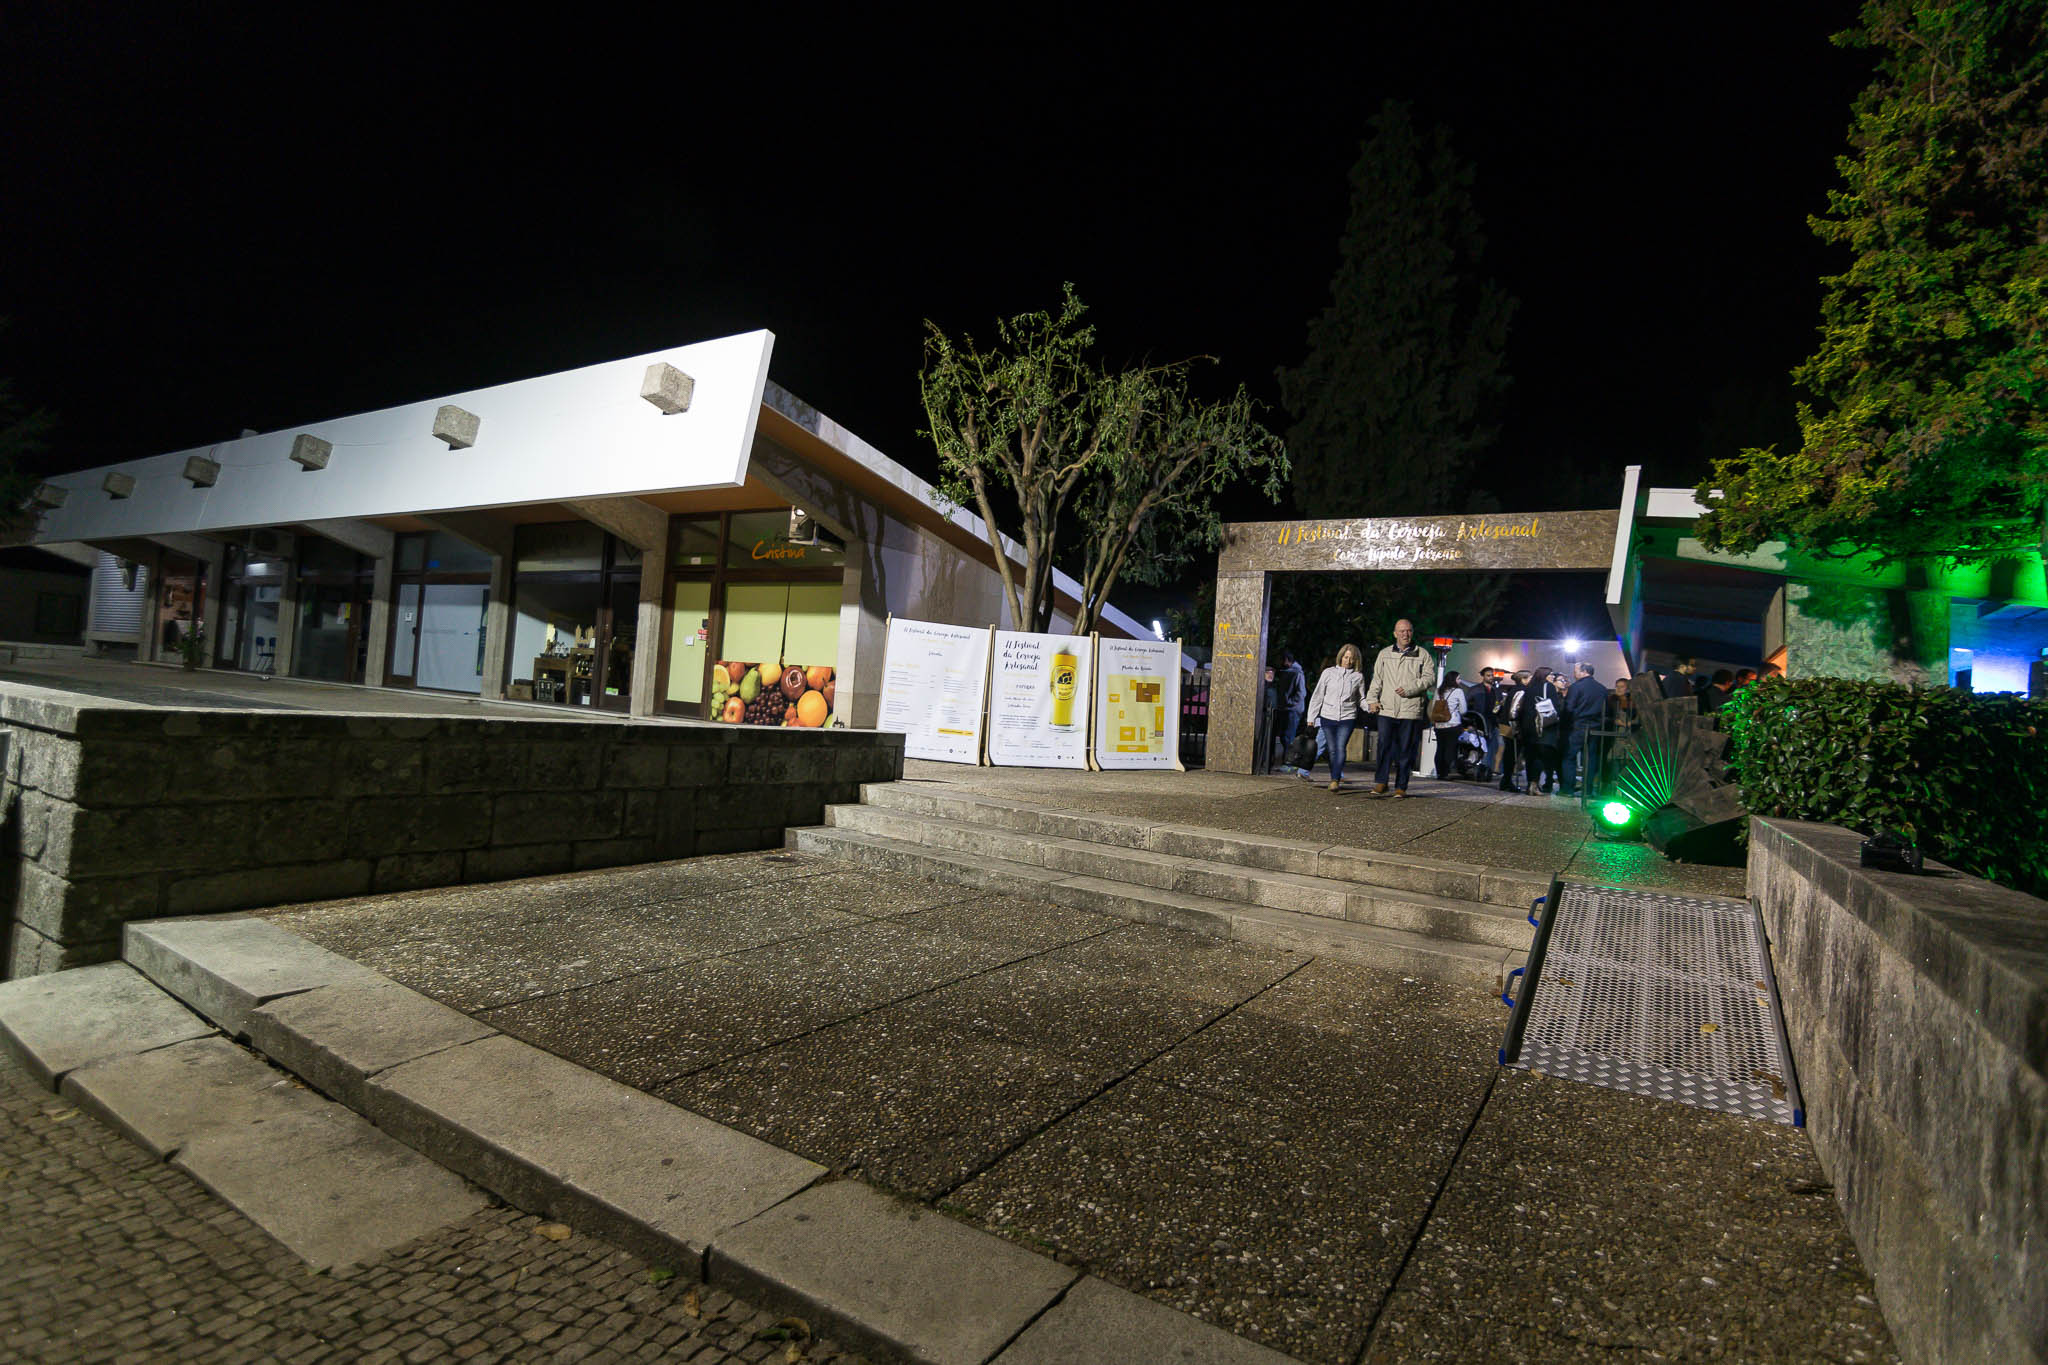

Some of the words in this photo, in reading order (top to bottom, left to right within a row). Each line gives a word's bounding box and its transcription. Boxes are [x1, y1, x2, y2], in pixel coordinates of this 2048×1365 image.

[1296, 522, 1351, 544] Festival
[1389, 522, 1448, 546] Cerveja
[1456, 517, 1542, 541] Artesanal
[752, 540, 806, 560] Cristina
[1013, 640, 1040, 649] Festival
[1016, 652, 1041, 663] Cerveja
[1004, 661, 1038, 671] Artesanal
